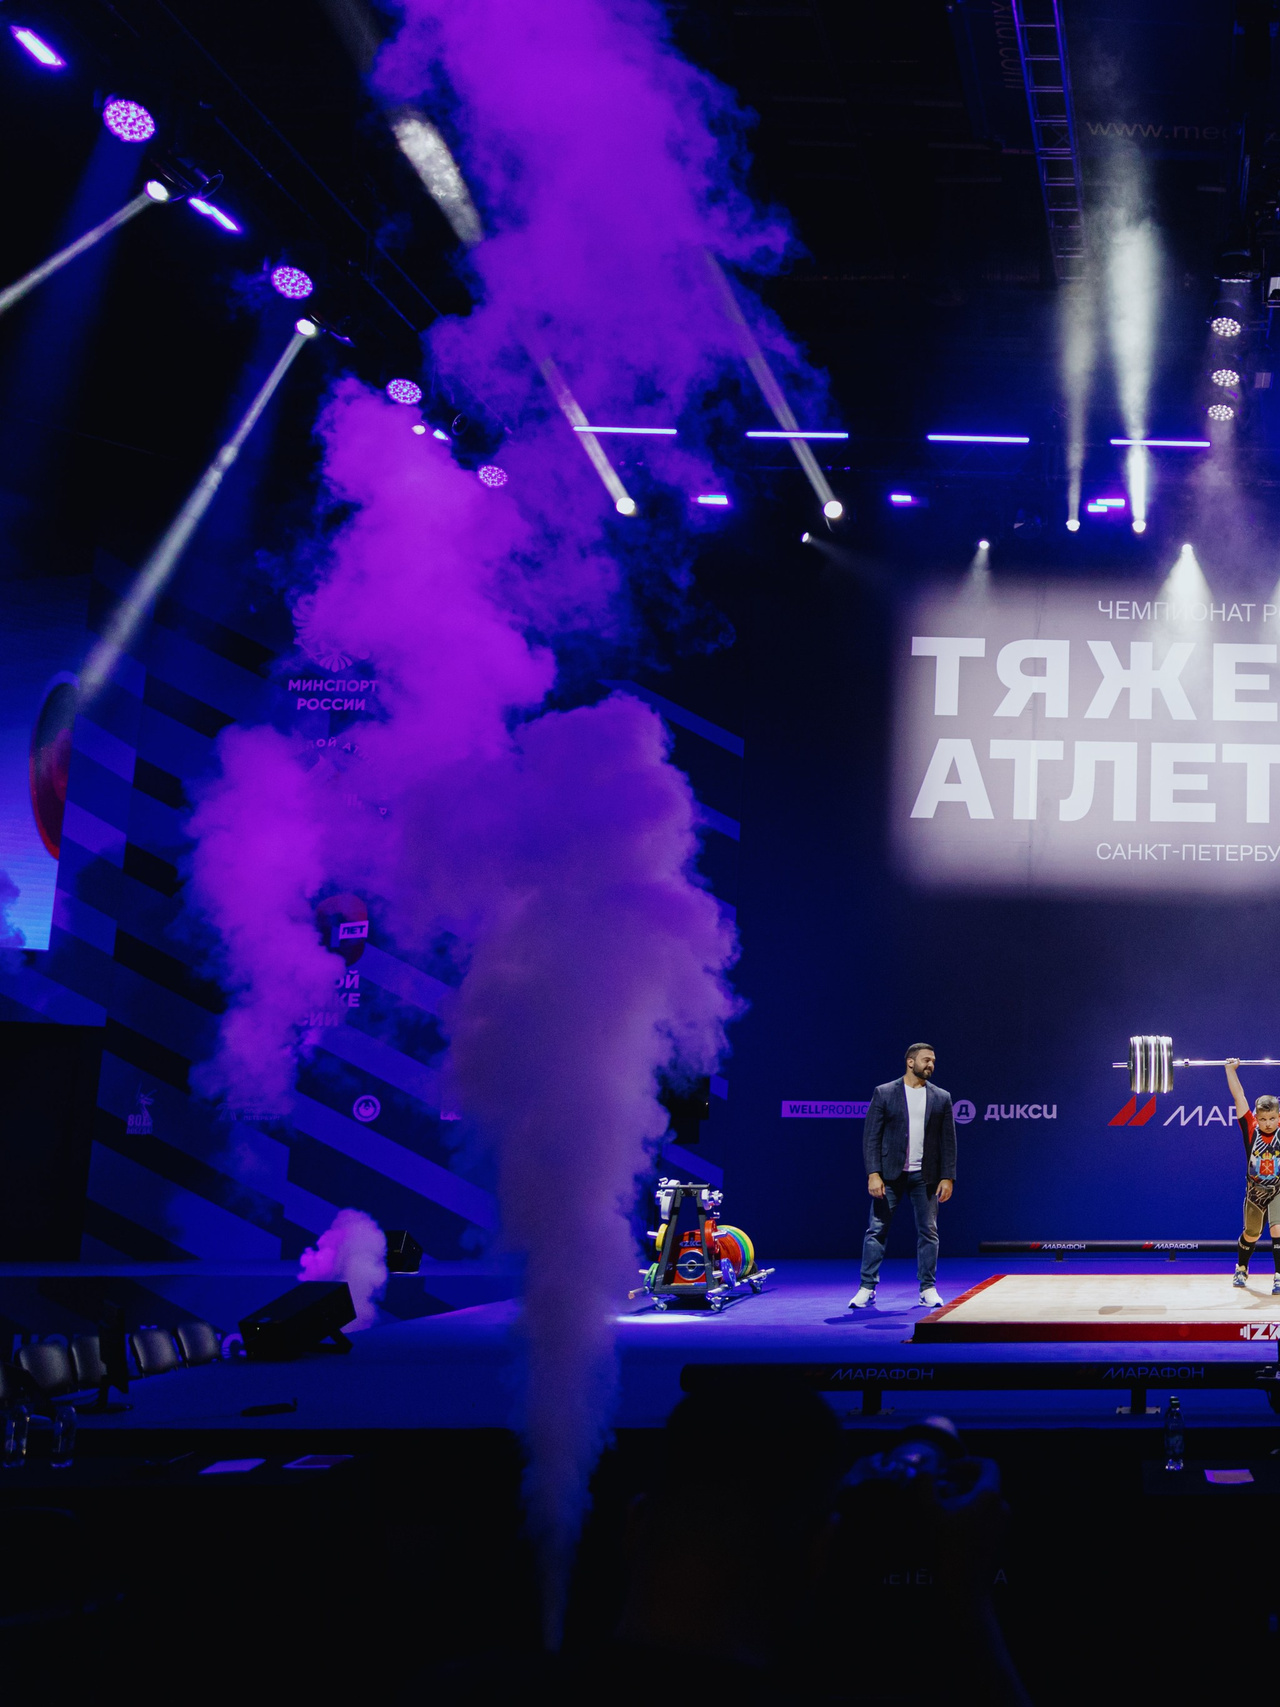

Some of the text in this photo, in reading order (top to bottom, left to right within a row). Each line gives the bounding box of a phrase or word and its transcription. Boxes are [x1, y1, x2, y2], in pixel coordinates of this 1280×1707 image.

[1097, 600, 1257, 623] ЧЕМПИОНАТ
[288, 679, 379, 692] МИНСПОРТ
[297, 698, 366, 711] РОССИИ
[342, 925, 366, 936] ЛЕТ
[789, 1104, 868, 1115] WELLPRODUC
[829, 1367, 935, 1381] МАРАФОН
[1101, 1365, 1205, 1379] МАРАФОН
